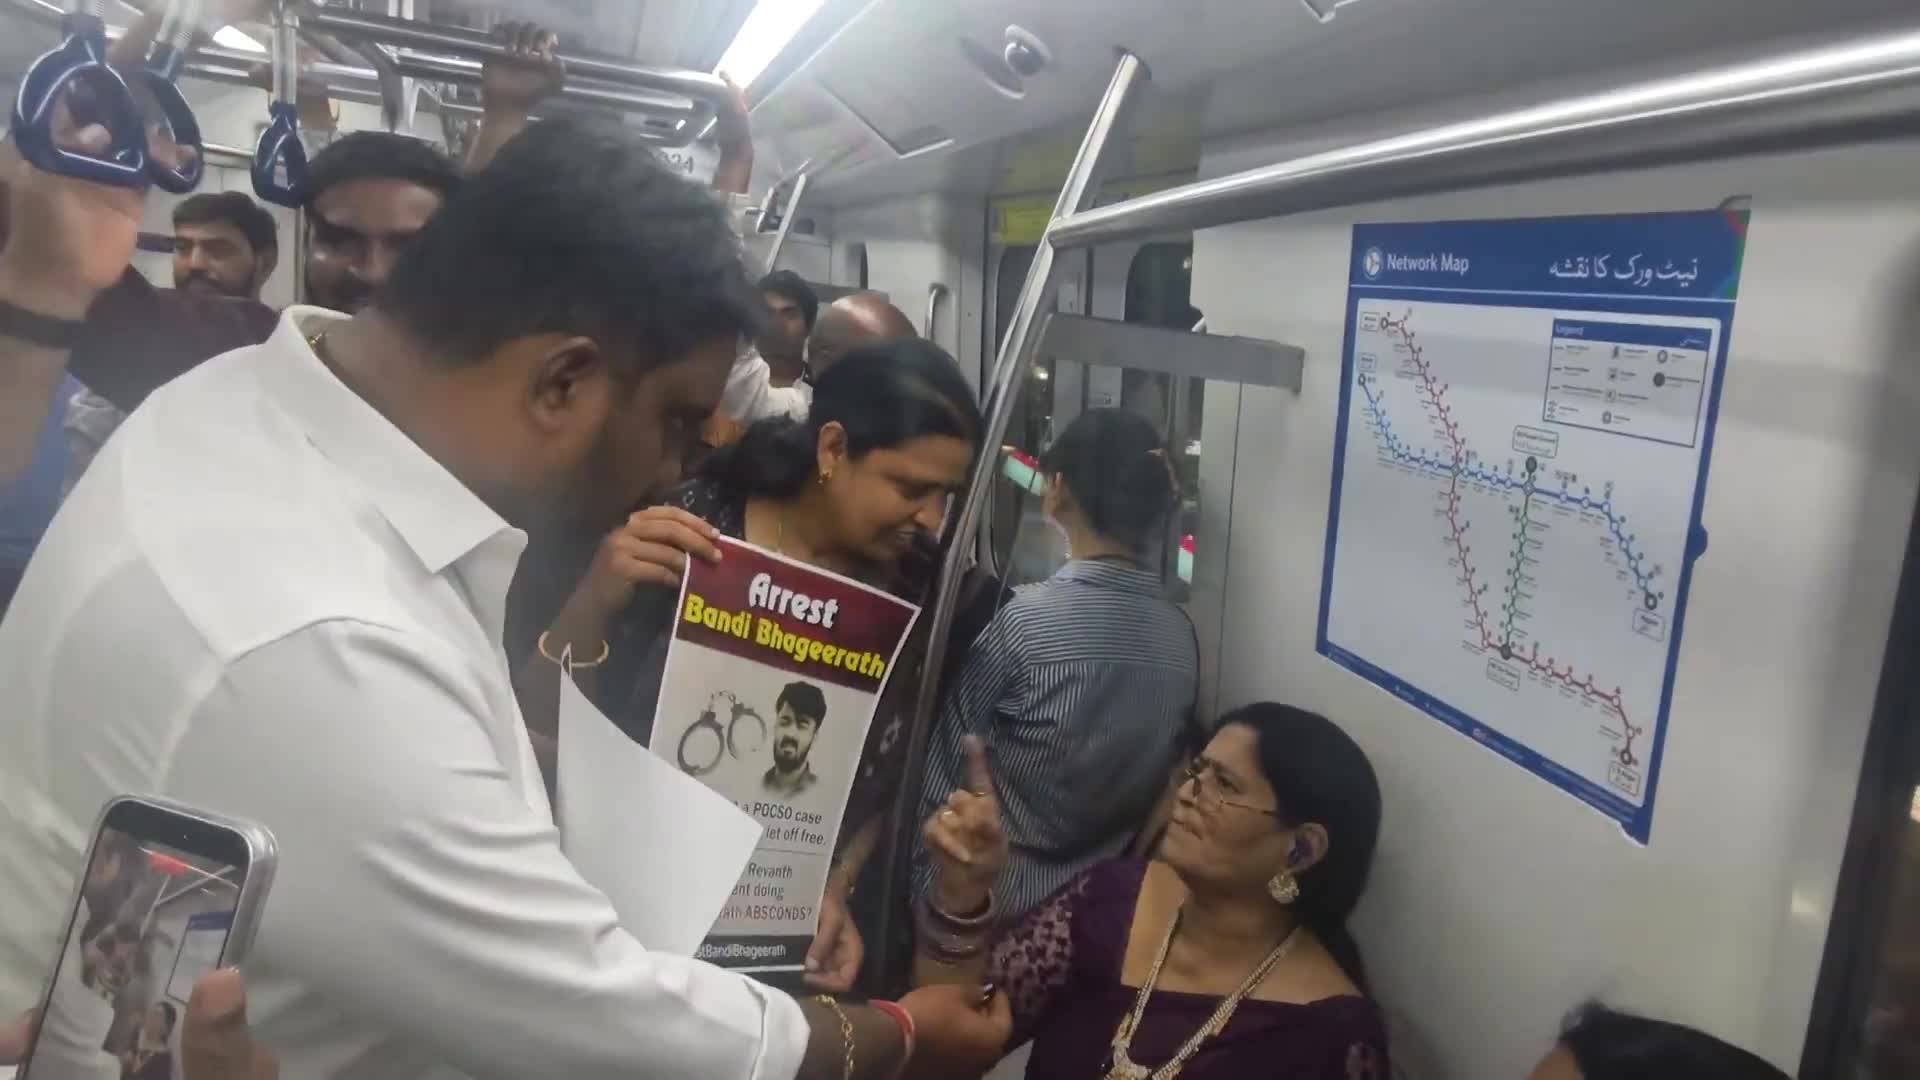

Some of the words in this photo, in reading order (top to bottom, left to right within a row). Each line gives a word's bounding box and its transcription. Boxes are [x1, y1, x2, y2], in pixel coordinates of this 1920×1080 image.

[1386, 253, 1438, 271] Network
[1440, 253, 1469, 276] Map
[1549, 256, 1590, 279] نقشہ
[1594, 253, 1611, 278] کا
[1614, 252, 1653, 287] ورک
[749, 572, 839, 629] Arrest
[684, 592, 752, 639] Bandi
[756, 617, 886, 679] Bhageerath
[753, 801, 793, 820] POCSO
[795, 810, 822, 825] case
[766, 825, 780, 840] let
[783, 826, 799, 841] off
[800, 829, 826, 845] free.
[748, 862, 793, 879] Revanth
[731, 883, 750, 896] ent
[753, 883, 785, 901] doing
[743, 904, 812, 921] ABSCONDS?
